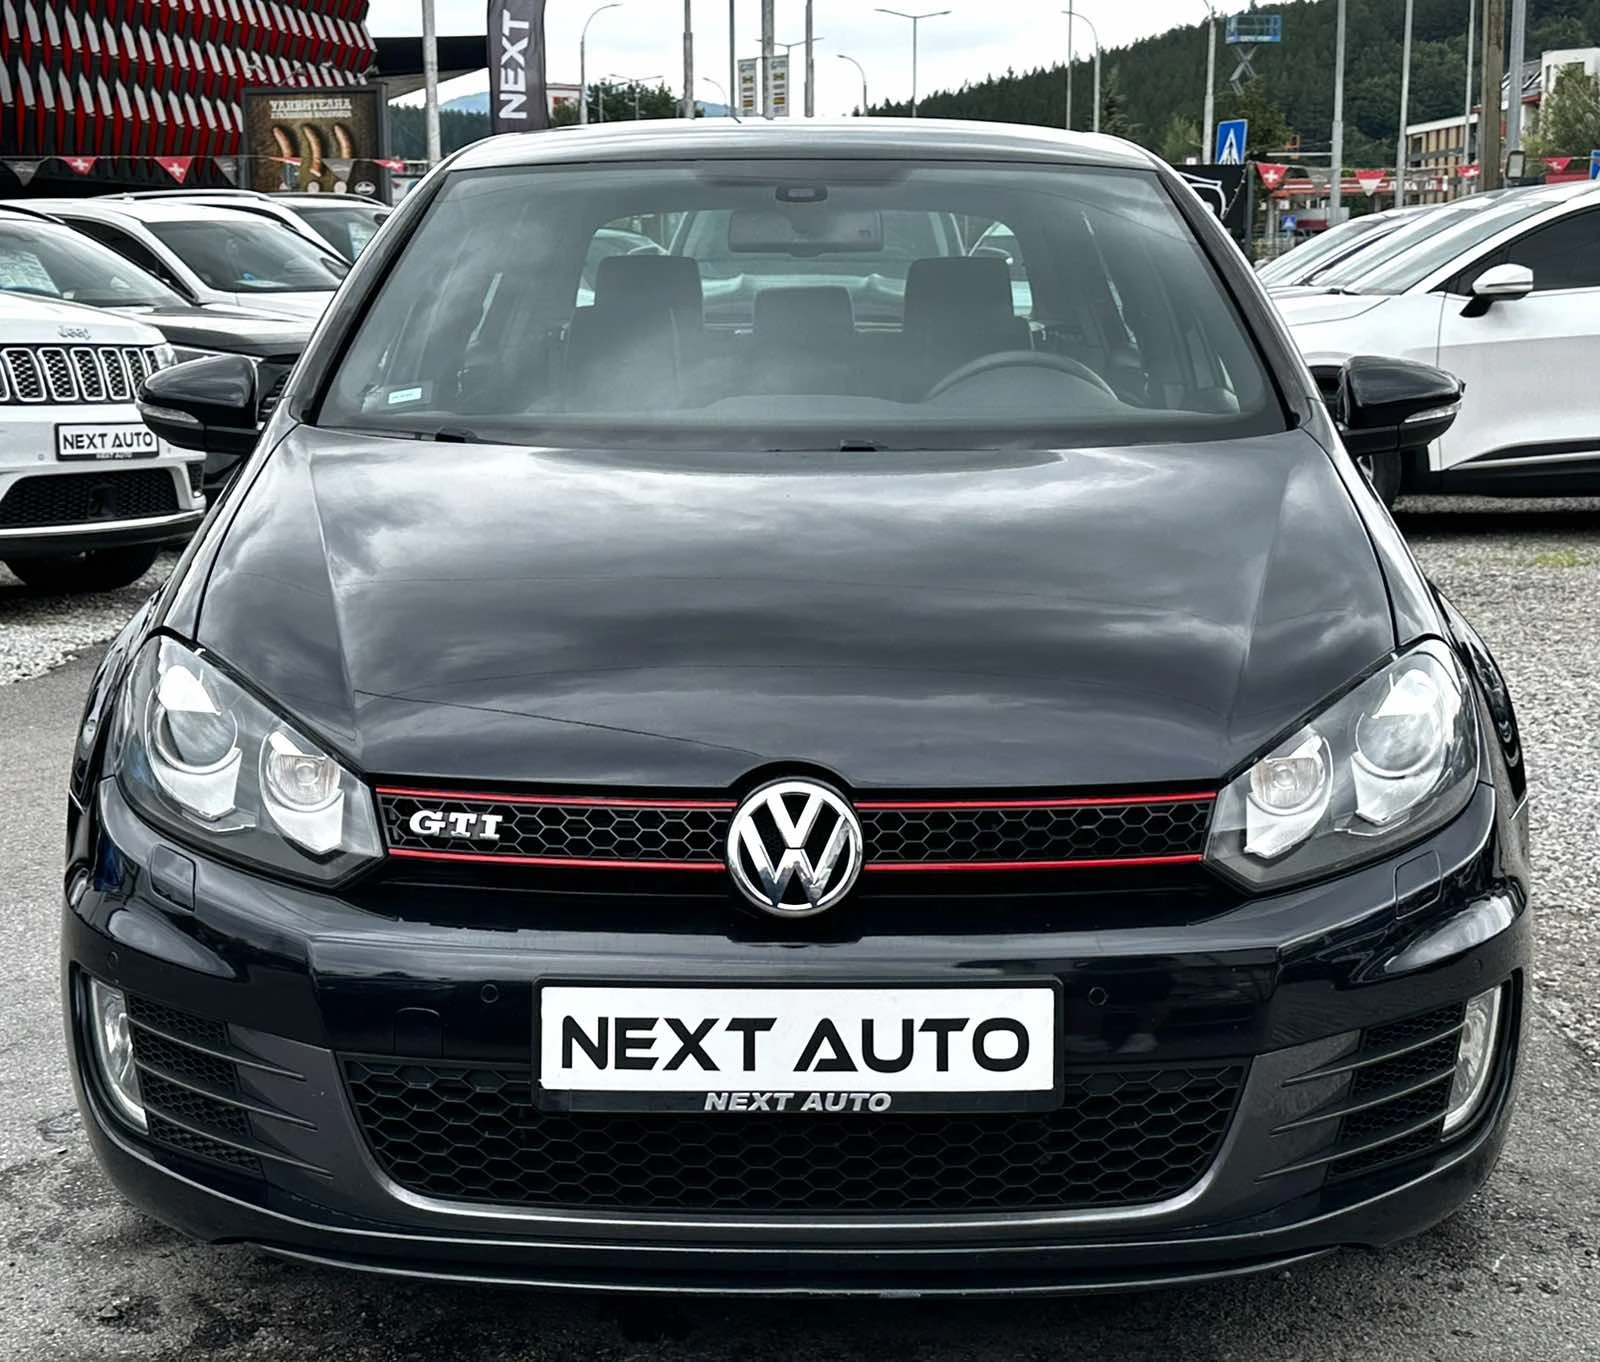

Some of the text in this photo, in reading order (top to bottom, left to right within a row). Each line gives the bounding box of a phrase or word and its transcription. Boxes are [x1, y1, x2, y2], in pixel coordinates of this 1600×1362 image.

[498, 9, 530, 119] NEXT
[63, 432, 153, 450] NEXT AUTO
[409, 809, 503, 842] GTI
[561, 1016, 1030, 1073] NEXT AUTO
[704, 1093, 893, 1112] NEXT AUTO
